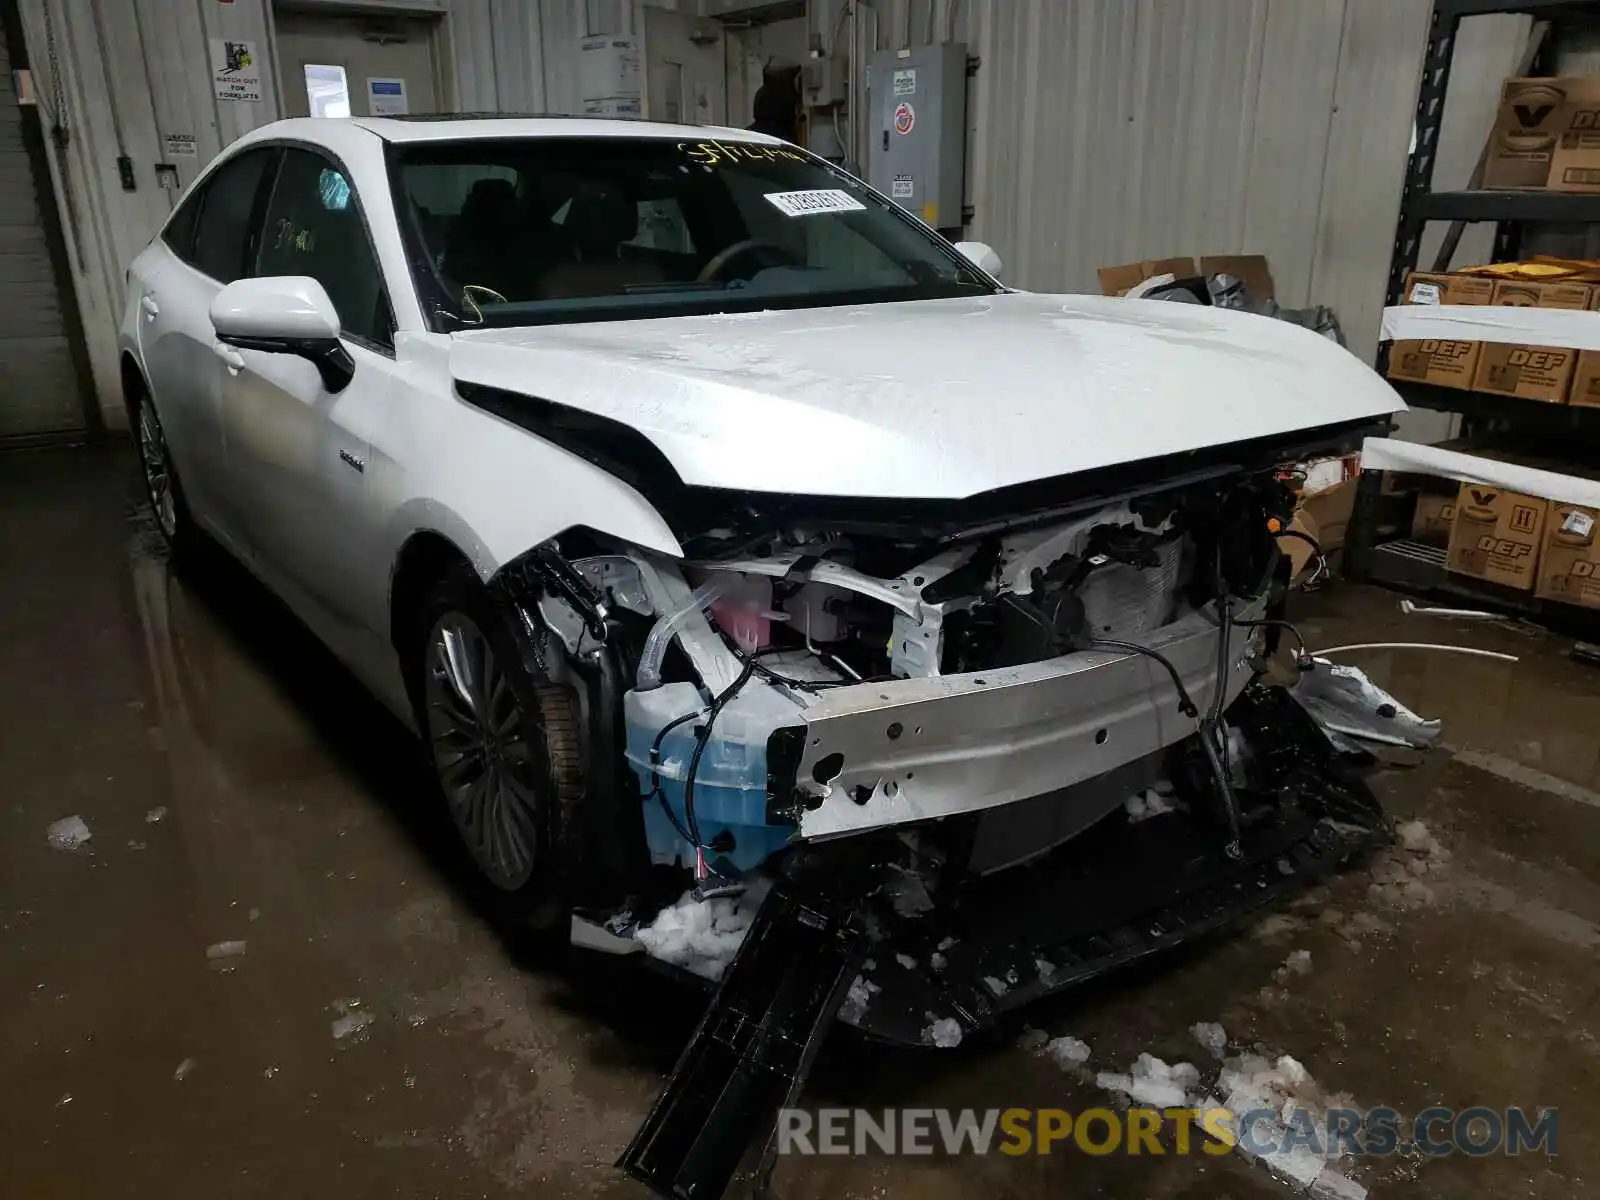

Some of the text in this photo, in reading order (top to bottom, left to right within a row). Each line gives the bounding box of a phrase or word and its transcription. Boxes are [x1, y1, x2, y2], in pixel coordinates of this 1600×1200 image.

[1418, 339, 1472, 359] DEF
[1507, 348, 1567, 371] DEF
[1477, 534, 1532, 558] DEF
